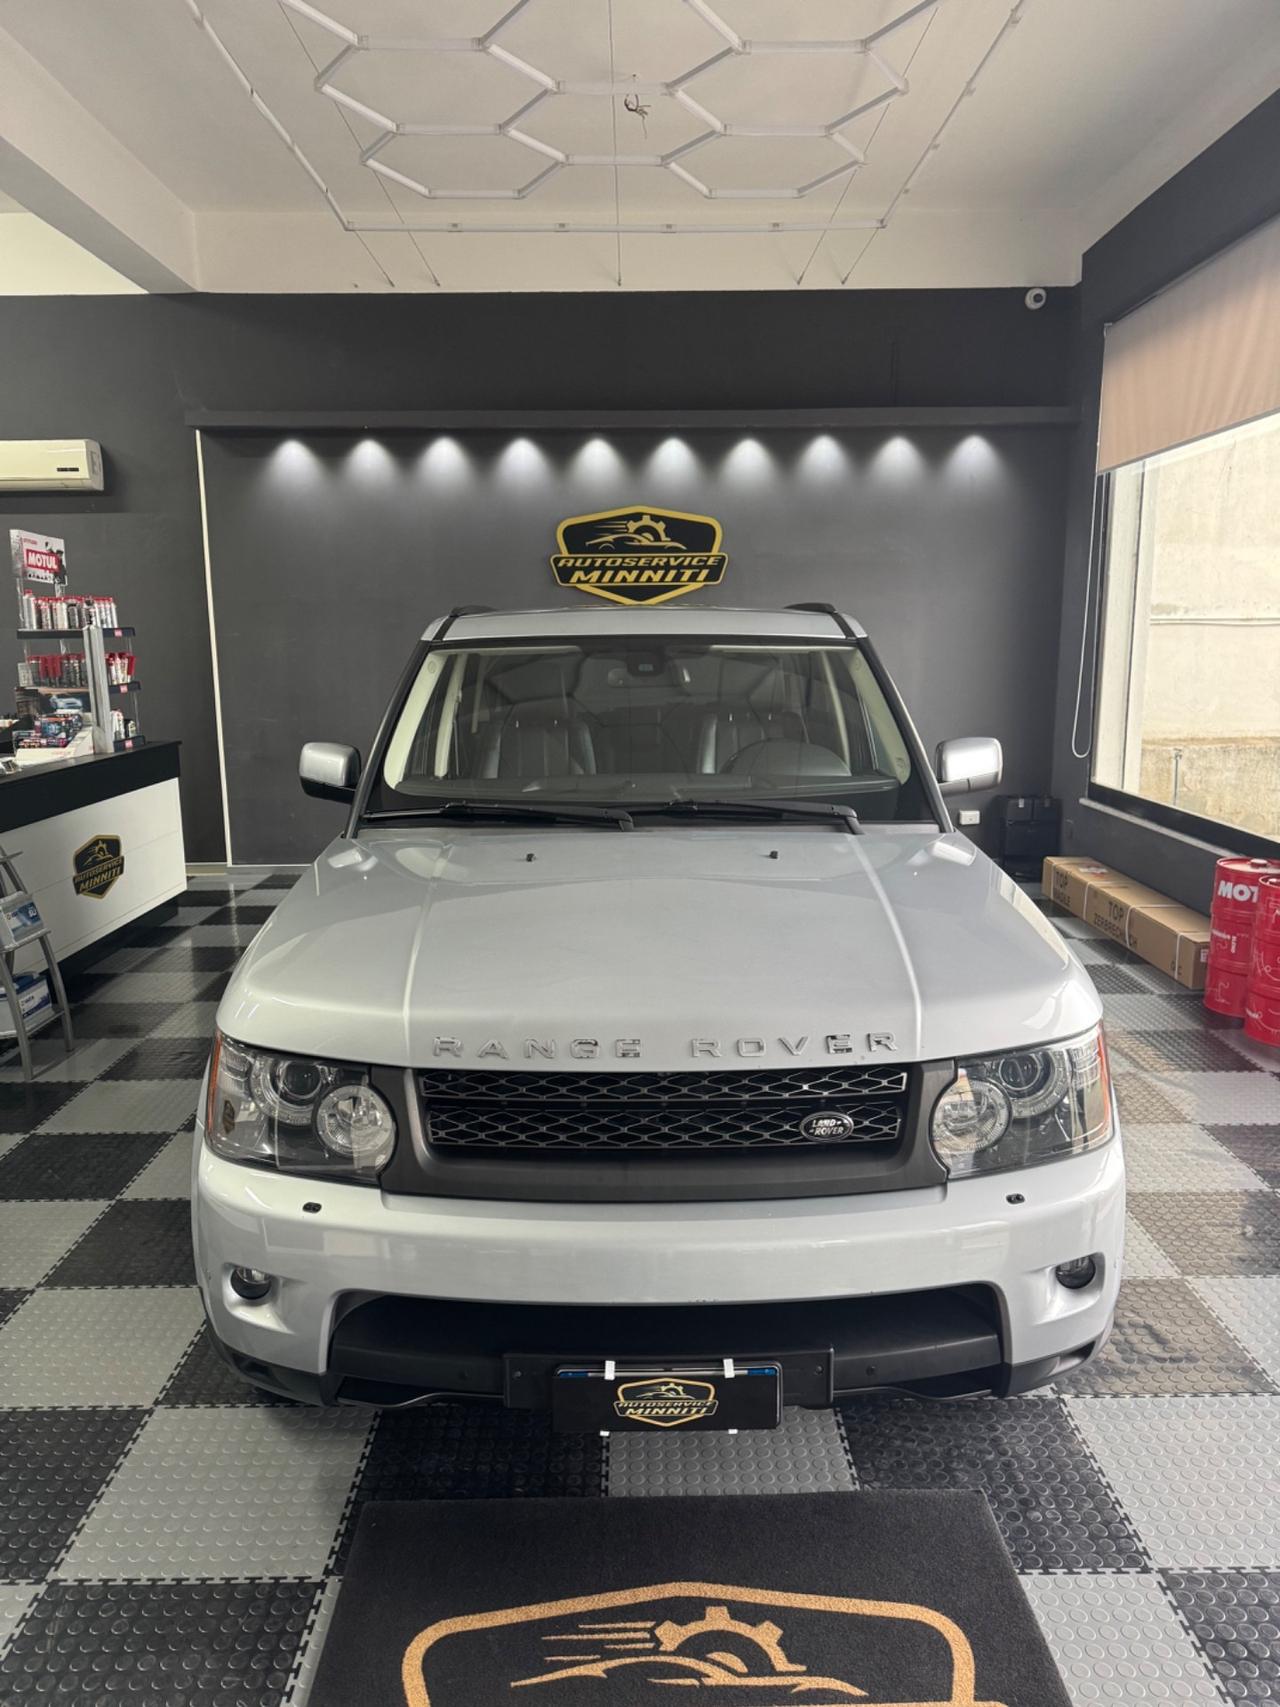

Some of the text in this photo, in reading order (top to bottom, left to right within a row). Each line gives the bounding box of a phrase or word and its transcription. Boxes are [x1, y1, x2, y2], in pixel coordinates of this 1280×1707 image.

[28, 551, 58, 569] MOTUL
[557, 556, 722, 567] AUTOSERVICE
[569, 568, 710, 583] MINNITI
[80, 866, 120, 891] MINNITI
[1108, 901, 1124, 920] TOP
[432, 1032, 899, 1060] RANGE ROVER
[812, 1119, 836, 1128] LAND
[814, 1126, 844, 1136] ROVER
[625, 1407, 707, 1415] MINNITI
